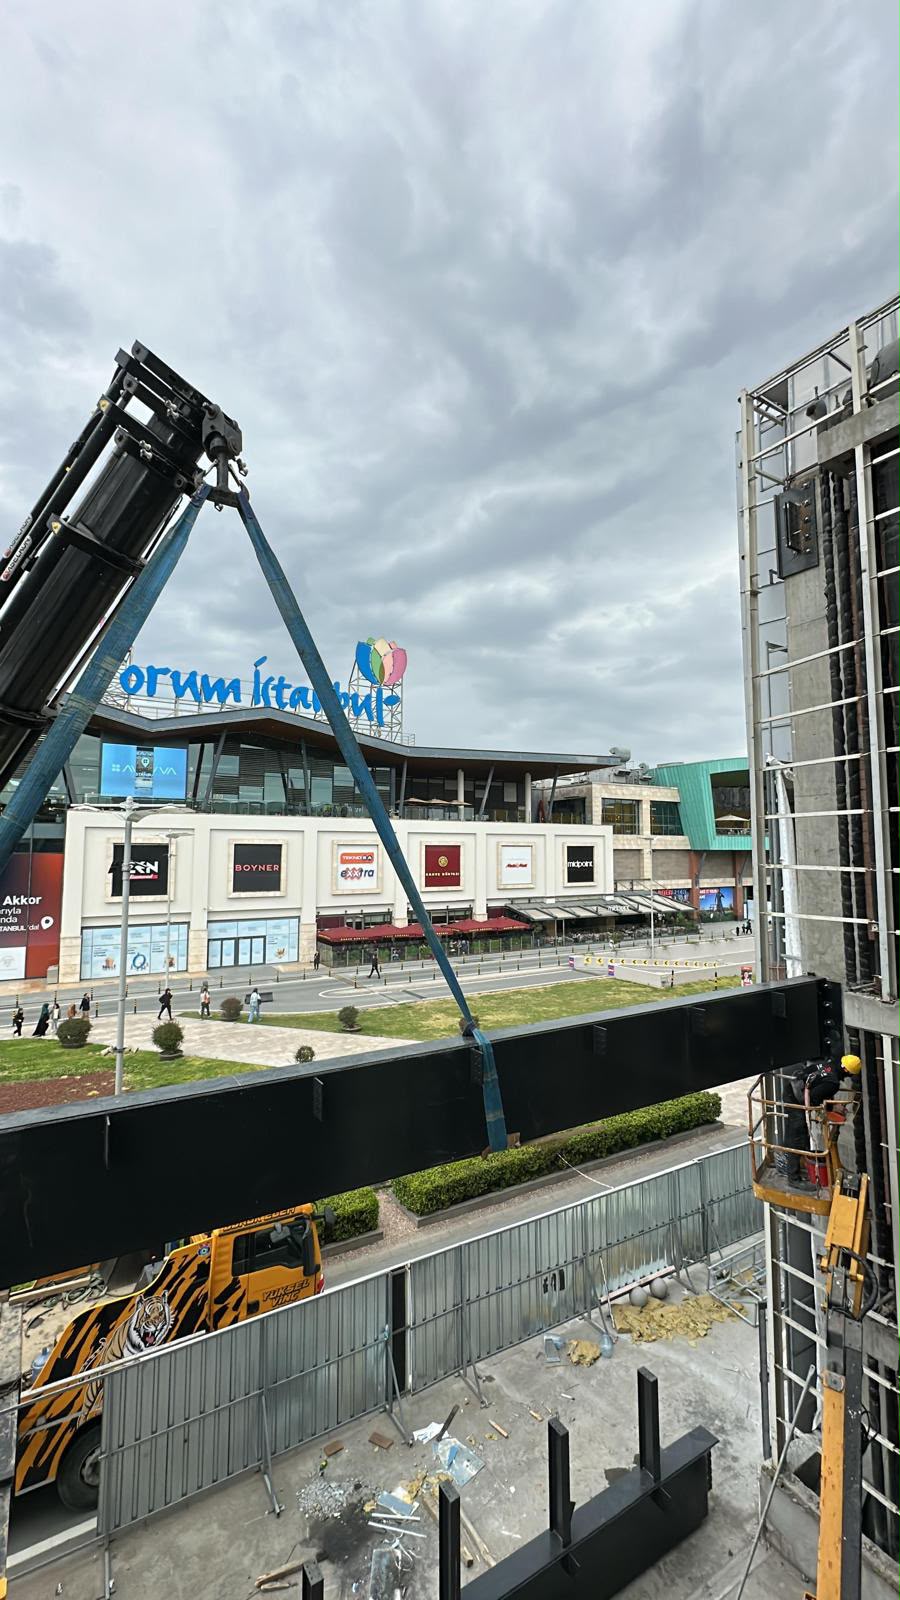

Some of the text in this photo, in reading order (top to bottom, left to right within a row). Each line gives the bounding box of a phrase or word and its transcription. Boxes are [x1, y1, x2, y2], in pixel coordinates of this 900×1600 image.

[120, 664, 242, 703] orum
[235, 864, 280, 872] BOYNER
[567, 860, 593, 868] midpoint
[2, 895, 42, 906] Akkor
